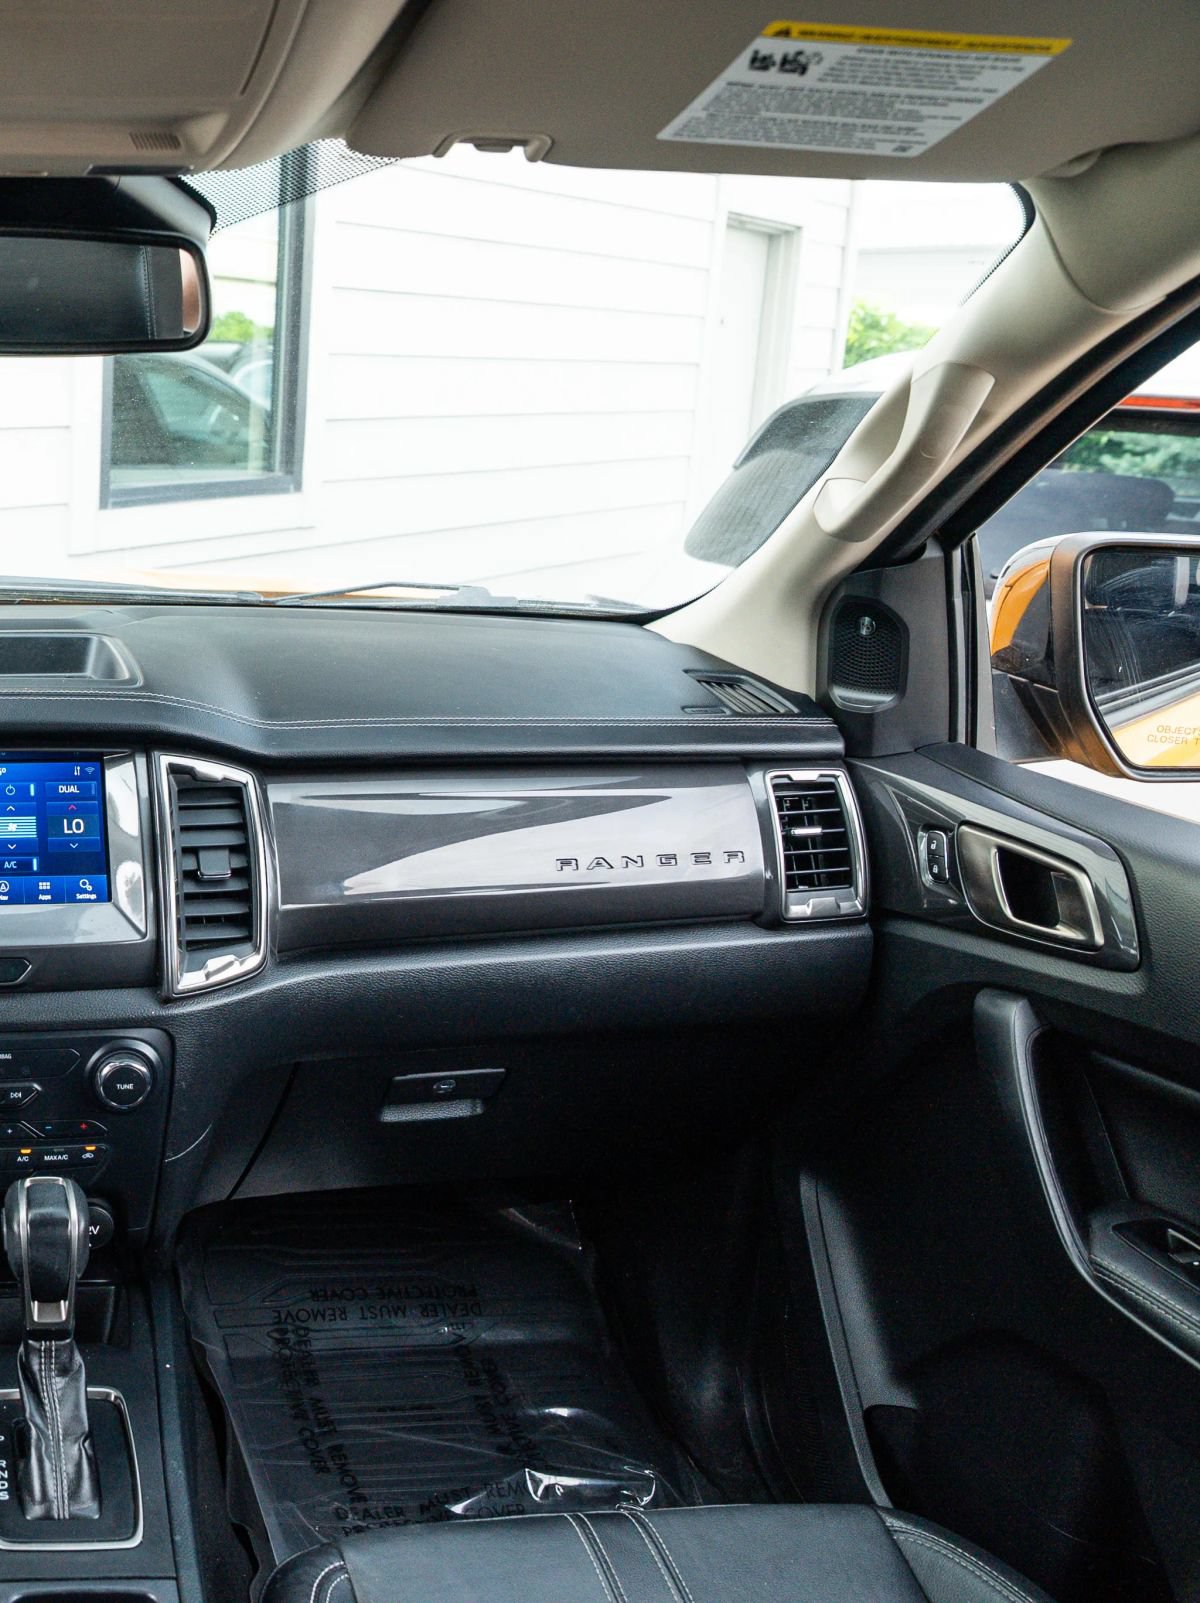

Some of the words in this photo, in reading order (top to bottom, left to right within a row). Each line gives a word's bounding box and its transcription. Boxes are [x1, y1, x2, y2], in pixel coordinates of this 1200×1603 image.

[1147, 734, 1188, 745] CLOSER
[59, 784, 80, 793] DUAL
[63, 818, 85, 834] LO
[4, 860, 17, 869] A/C
[555, 850, 746, 871] RANGER
[38, 894, 51, 902] Apps
[76, 893, 97, 902] Settings
[308, 1288, 368, 1303] COVER
[375, 1284, 478, 1300] PROTECTIVE
[271, 1307, 347, 1325] REMOVE
[358, 1305, 406, 1320] MUST
[420, 1302, 482, 1319] DEALER
[299, 1428, 330, 1474] COVER
[310, 1398, 338, 1434] MUST
[328, 1444, 368, 1504] REMOVE
[0, 1491, 9, 1500] S
[464, 1503, 526, 1520] COVER
